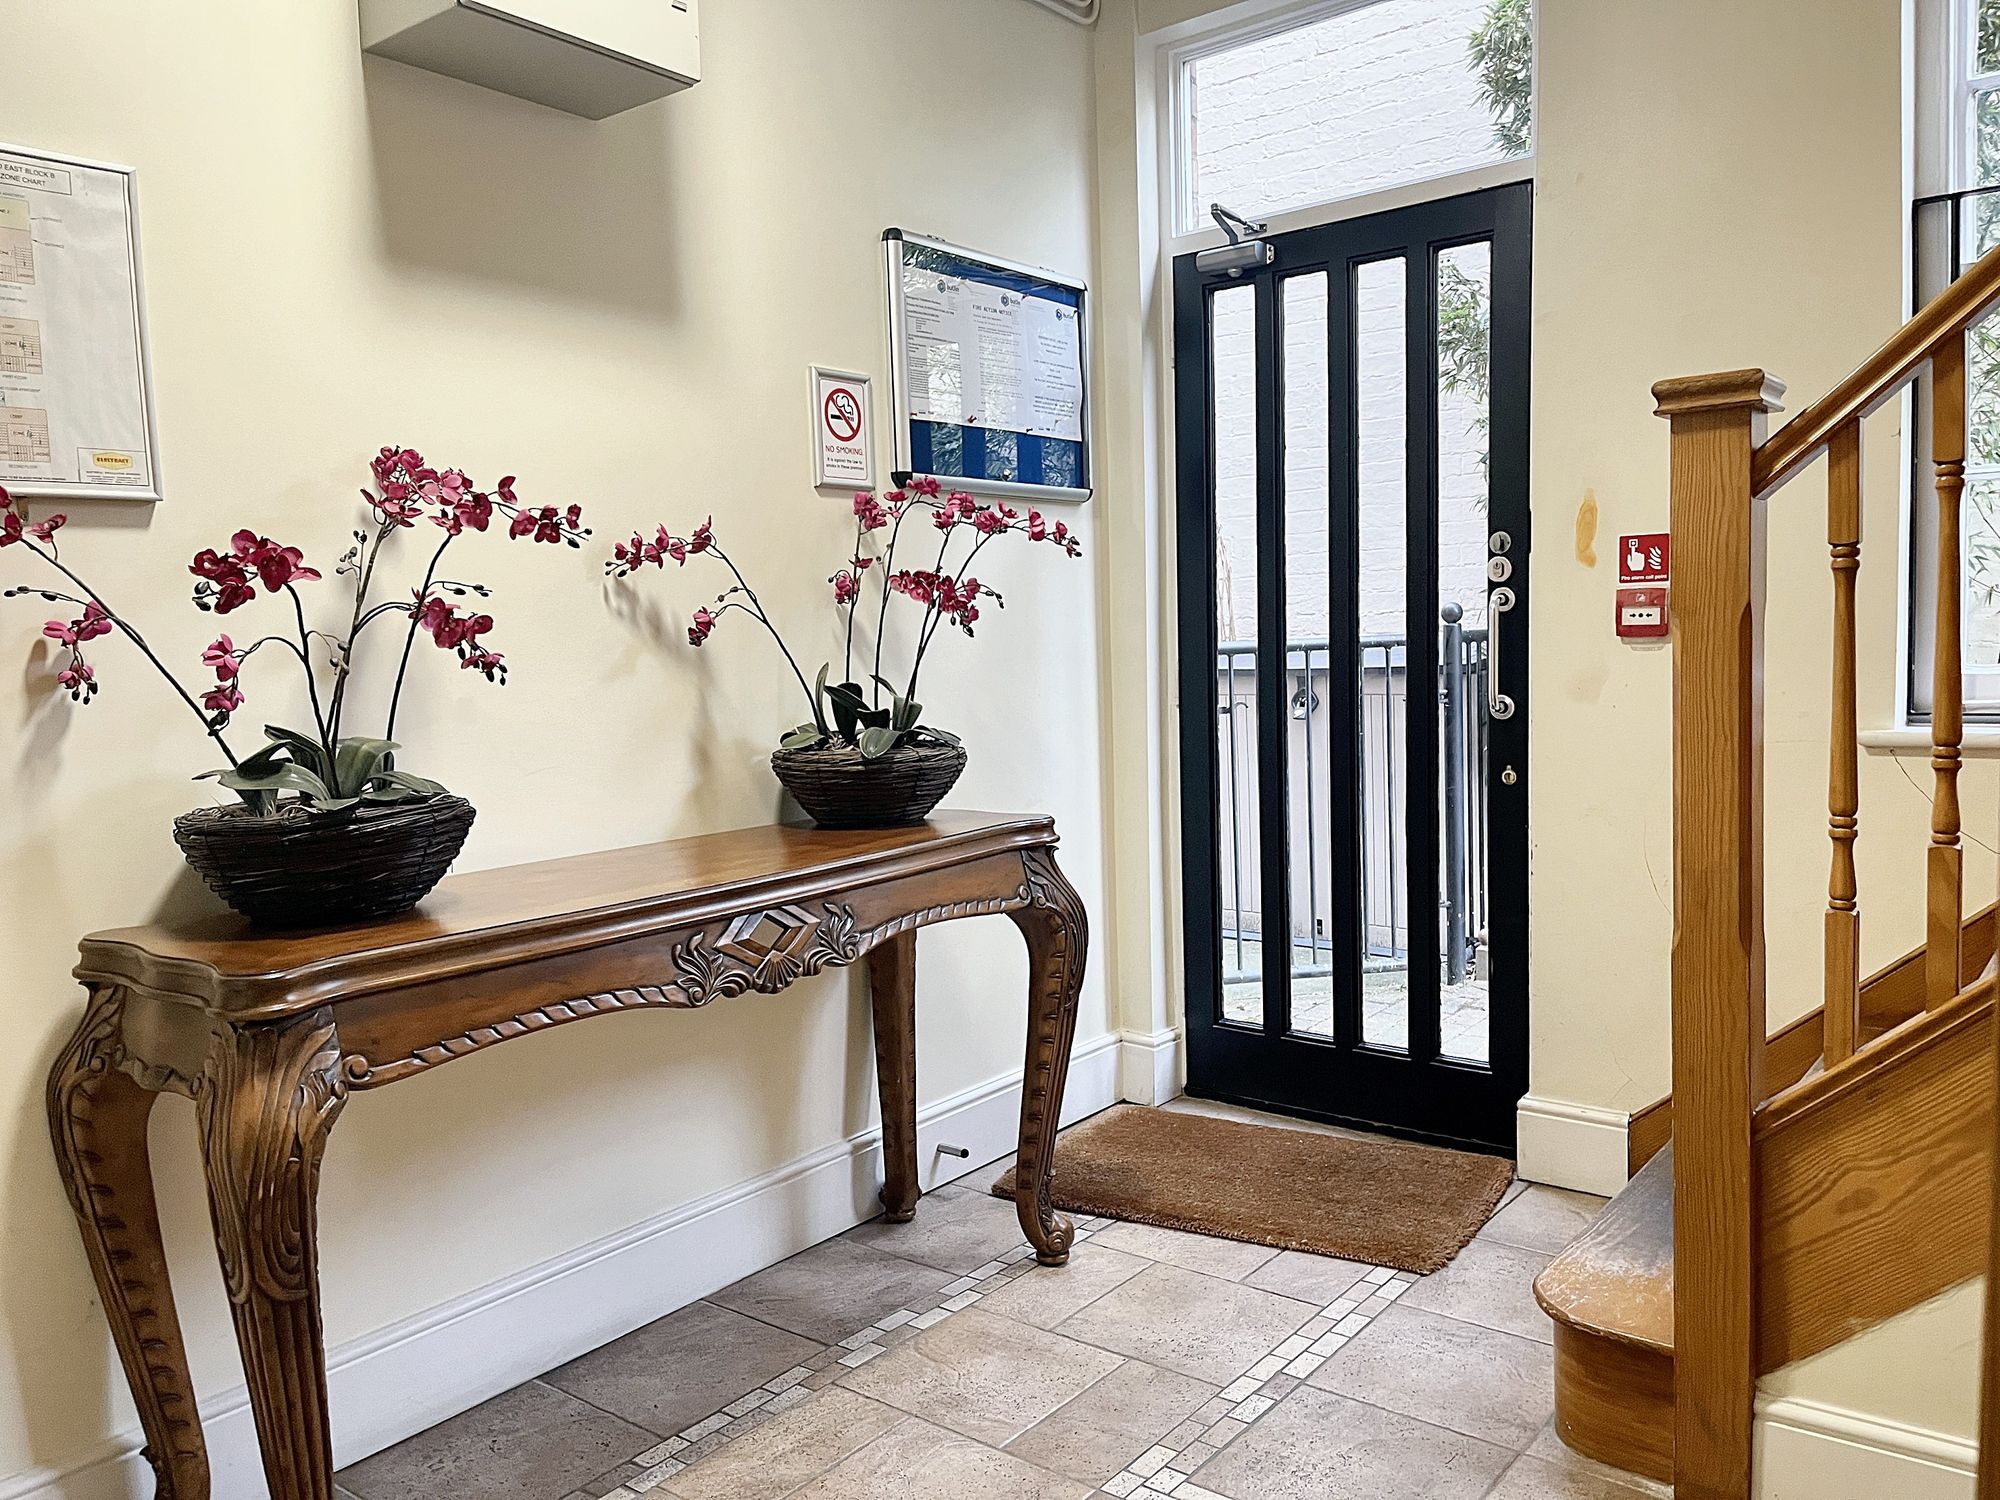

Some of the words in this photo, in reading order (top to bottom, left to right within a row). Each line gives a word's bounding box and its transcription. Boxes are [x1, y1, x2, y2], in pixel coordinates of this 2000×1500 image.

[4, 164, 23, 172] EAST
[25, 168, 49, 178] BLOCK
[22, 177, 46, 186] CHART
[825, 445, 835, 453] NO
[835, 446, 863, 455] SMOKING
